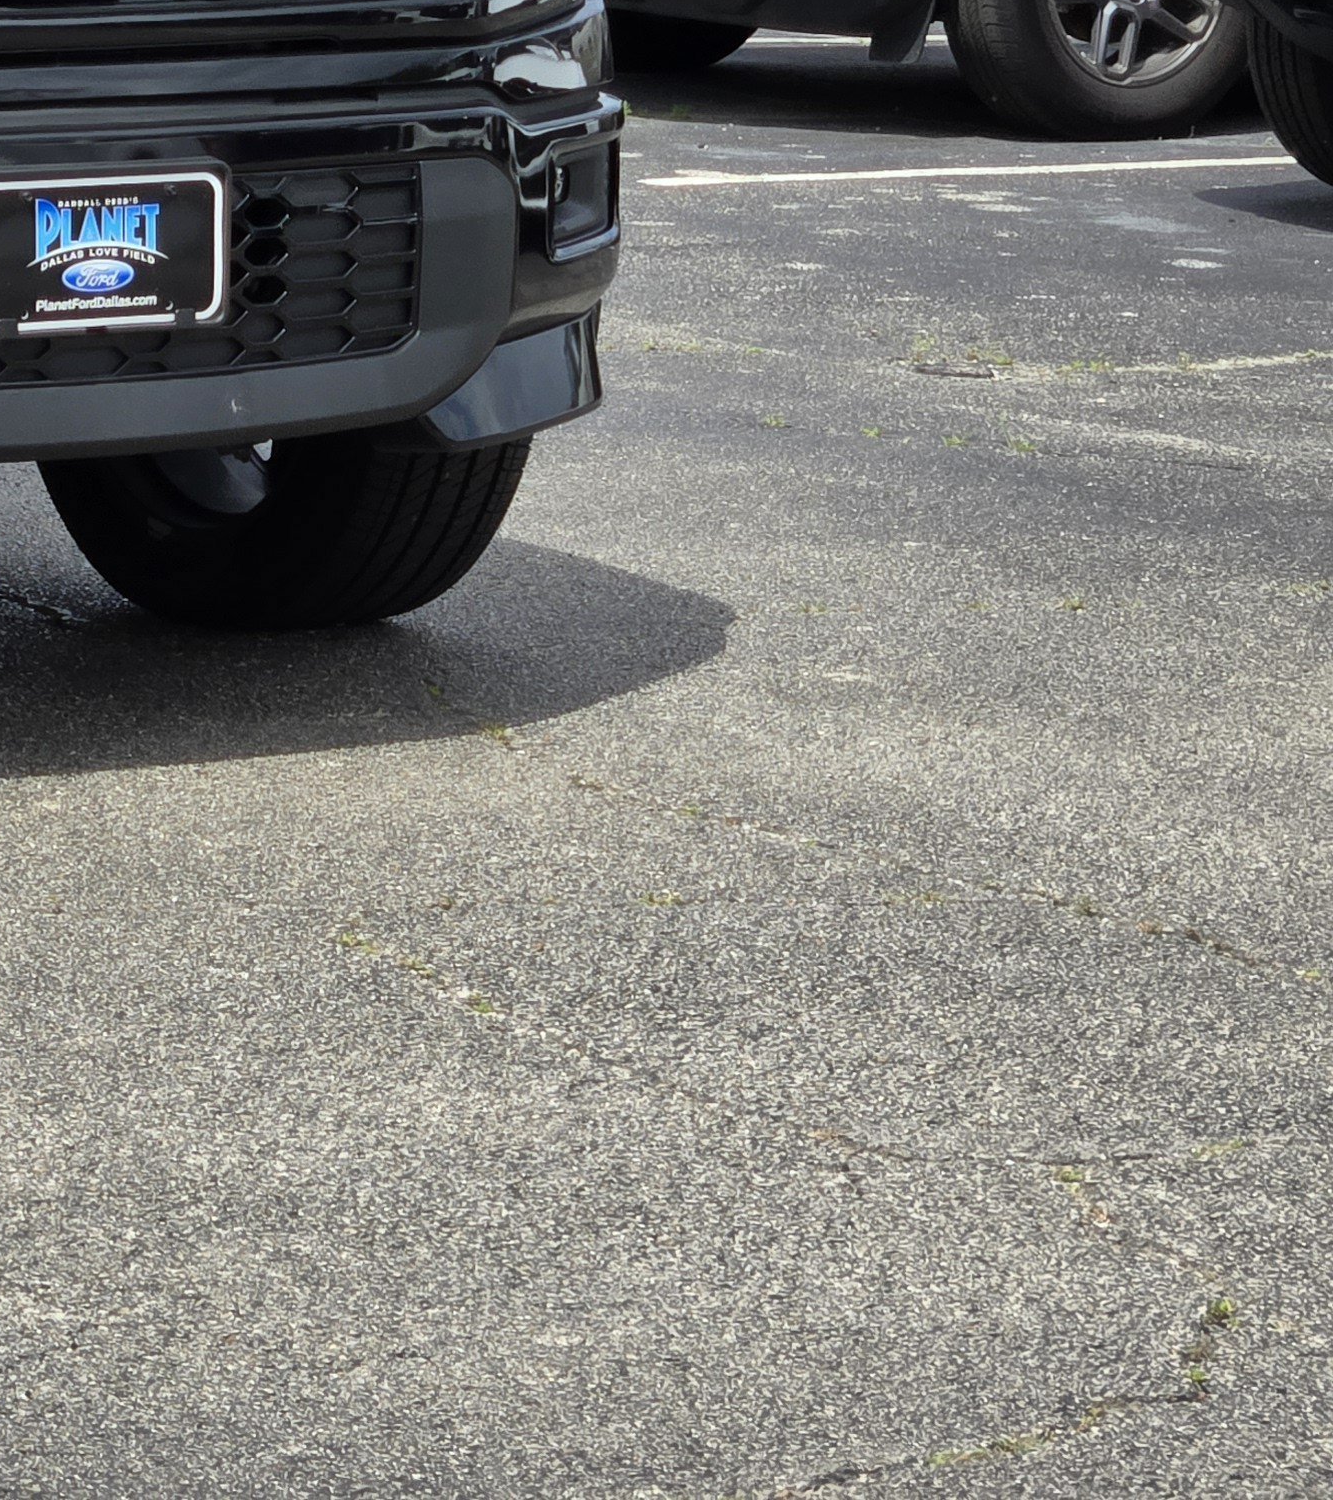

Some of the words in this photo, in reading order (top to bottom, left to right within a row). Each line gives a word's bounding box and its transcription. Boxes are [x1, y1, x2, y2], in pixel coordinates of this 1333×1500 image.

[35, 198, 160, 261] PLANET
[40, 250, 84, 272] DALLAS
[89, 248, 118, 257] LOVE
[123, 249, 156, 265] FIELD
[75, 265, 119, 287] Ford
[35, 295, 158, 313] PlanetFordDallas.com
